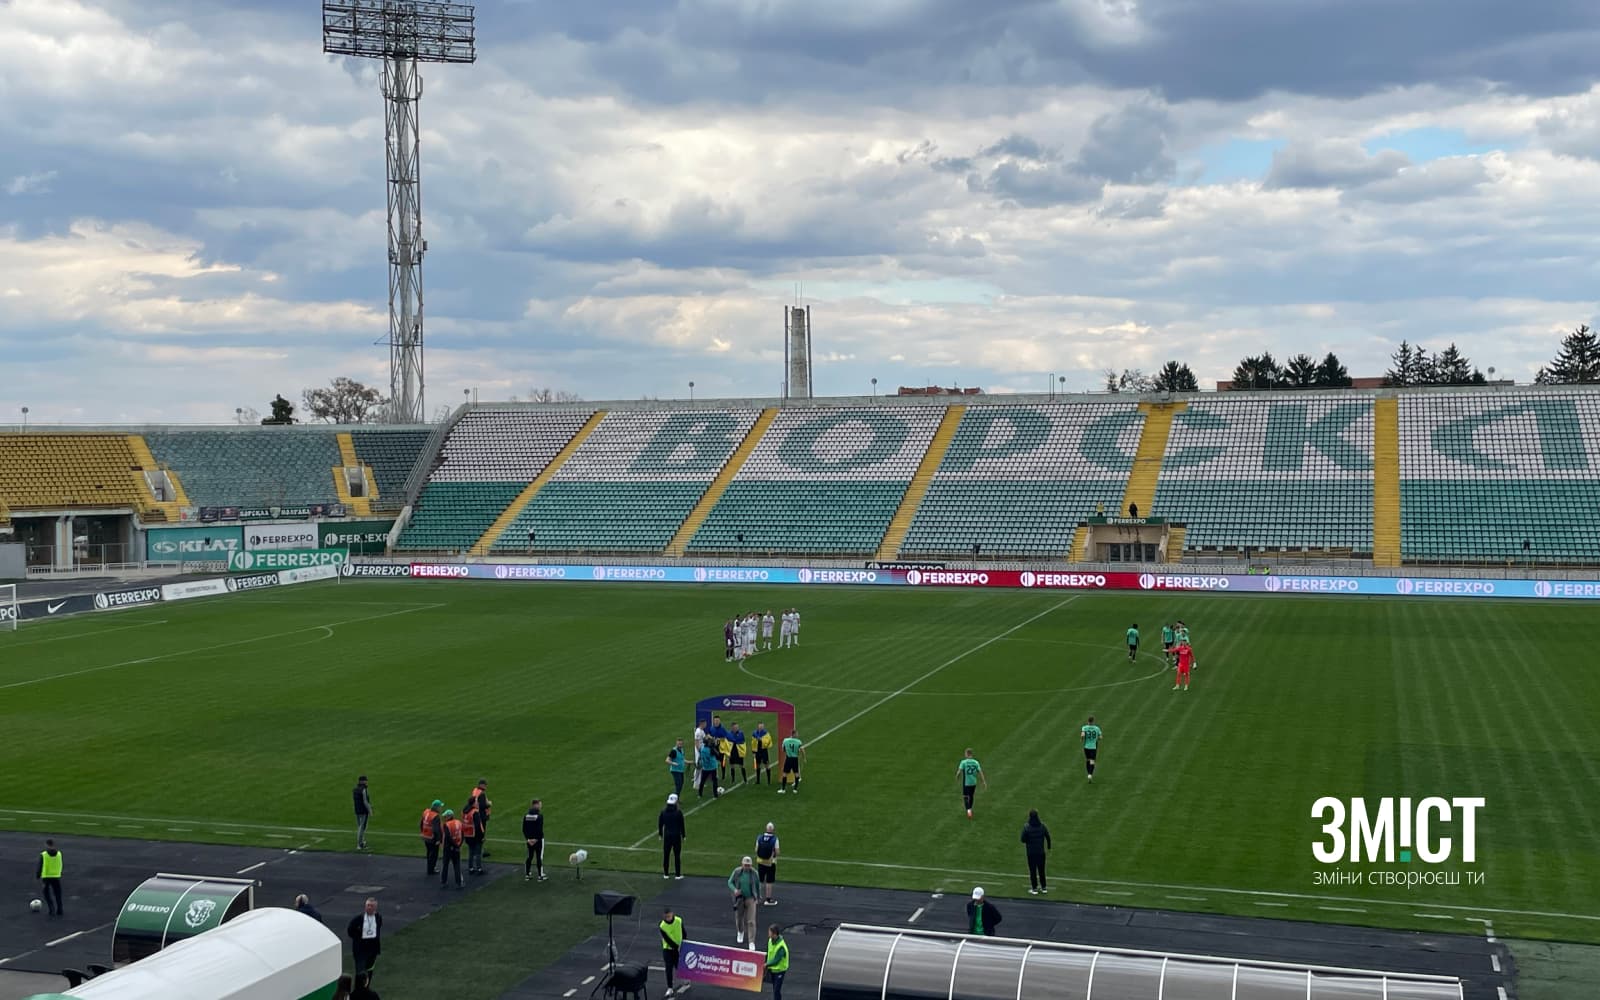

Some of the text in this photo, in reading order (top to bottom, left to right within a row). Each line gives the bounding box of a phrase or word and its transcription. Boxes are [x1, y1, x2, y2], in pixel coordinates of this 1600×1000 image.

[262, 534, 314, 545] FERREXPO
[256, 551, 344, 567] FERREXPO
[355, 565, 410, 576] FERREXPO
[414, 565, 469, 576] FERREXPO
[508, 567, 566, 578] FERREXPO
[607, 568, 665, 579] FERREXPO
[708, 569, 769, 580] FERREXPO
[813, 570, 877, 582] FERREXPO
[236, 574, 278, 589] FERREXPO
[922, 572, 989, 584] FERREXPO
[1036, 573, 1106, 587] FERREXPO
[1157, 575, 1229, 589] FERREXPO
[1282, 577, 1359, 591] FERREXPO
[1415, 580, 1495, 594] FERREXPO
[108, 588, 160, 606] FERREXPO
[789, 743, 795, 752] 4
[135, 904, 170, 913] FERREXPO
